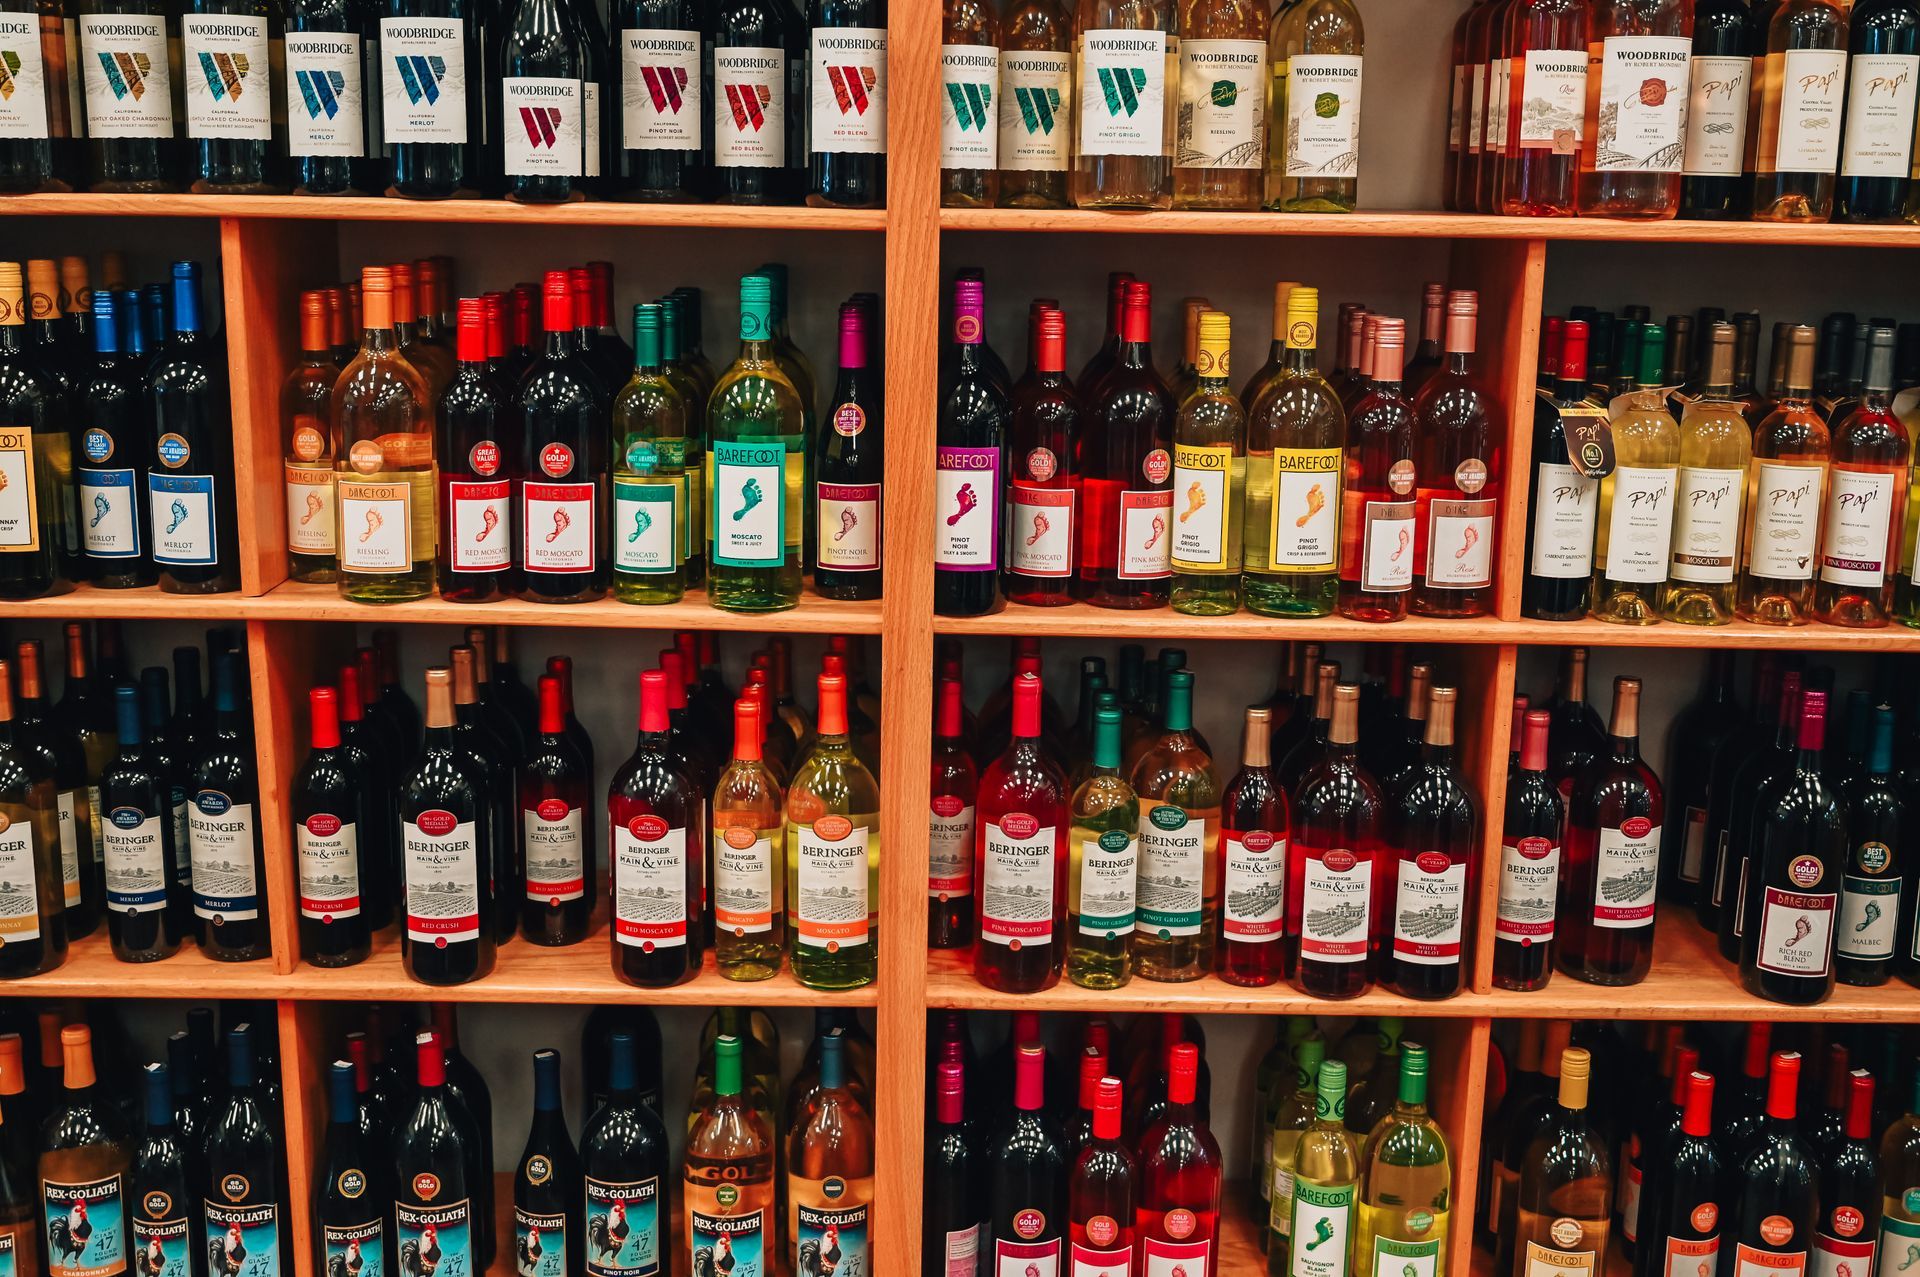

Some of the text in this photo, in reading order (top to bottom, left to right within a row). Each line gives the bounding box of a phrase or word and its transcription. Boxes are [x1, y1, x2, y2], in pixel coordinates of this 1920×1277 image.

[88, 25, 160, 36] WOODBRIDGE
[189, 25, 259, 37] WOODBRIDGE
[386, 27, 455, 39] WOODBRIDGE
[289, 43, 353, 54] WOODBRIDGE
[631, 39, 695, 51] WOODBRIDGE
[819, 39, 886, 50] WOODBRIDGE
[1090, 40, 1158, 52] WOODBRIDGE
[1191, 54, 1258, 63] WOODBRIDGE
[1617, 51, 1686, 61] WOODBRIDGE
[718, 58, 779, 69] WOODBRIDGE
[1007, 61, 1067, 72] WOODBRIDGE
[1296, 68, 1358, 77] WOODBRIDGE
[1703, 70, 1742, 100] Papi
[1799, 64, 1839, 95] Papi
[1866, 67, 1908, 98] Papi
[510, 85, 574, 96] WOODBRIDGE
[717, 448, 780, 463] BAREFOOT
[1280, 455, 1338, 469] BAREFOOT
[348, 487, 398, 498] BAREFOOT
[1628, 481, 1668, 510] Papi
[1689, 480, 1730, 509] Papi
[1769, 480, 1809, 509] Papi
[1838, 484, 1879, 513] Papi
[480, 547, 507, 555] MOSCATO
[550, 549, 583, 557] MOSCATO
[1828, 559, 1875, 569] PINK MOSCATO
[190, 819, 245, 831] BERINGER
[106, 835, 155, 845] BERINGER
[1139, 833, 1198, 847] BERINGER
[408, 841, 470, 852] BERINGER
[628, 846, 670, 854] BERINGER
[802, 845, 863, 856] BERINGER
[989, 842, 1049, 856] BERINGER
[1089, 858, 1134, 868] BERINGER
[1507, 863, 1554, 873] BERINGER
[1795, 866, 1818, 874] GOLD!
[1778, 893, 1826, 908] BAREFOOT
[1142, 913, 1161, 921] PINOT
[1851, 937, 1881, 947] MALBEC
[1778, 948, 1796, 956] RICH
[1783, 955, 1805, 963] BLEND
[47, 1182, 117, 1199] REX-GOLIATH
[588, 1183, 654, 1199] REX-GOLIATH
[1296, 1183, 1351, 1205] BAREFOOT
[207, 1209, 273, 1223] REX-GOLIATH
[399, 1208, 465, 1224] REX-GOLIATH
[801, 1210, 865, 1225] REX-GOLIATH
[1836, 1214, 1858, 1225] GOLD!
[694, 1216, 759, 1231] REX-GOLIATH
[1019, 1219, 1039, 1227] GOLD!
[328, 1224, 380, 1241] REX-GOLIATH
[95, 1236, 113, 1251] 47
[632, 1238, 649, 1251] 47
[444, 1260, 462, 1275] 47
[543, 1259, 558, 1269] 47
[1301, 1257, 1334, 1268] SAUVIGNON
[63, 1267, 109, 1277] CHARDONNAY
[603, 1268, 640, 1277] PINOT NOIR
[1307, 1265, 1326, 1273] BLANC
